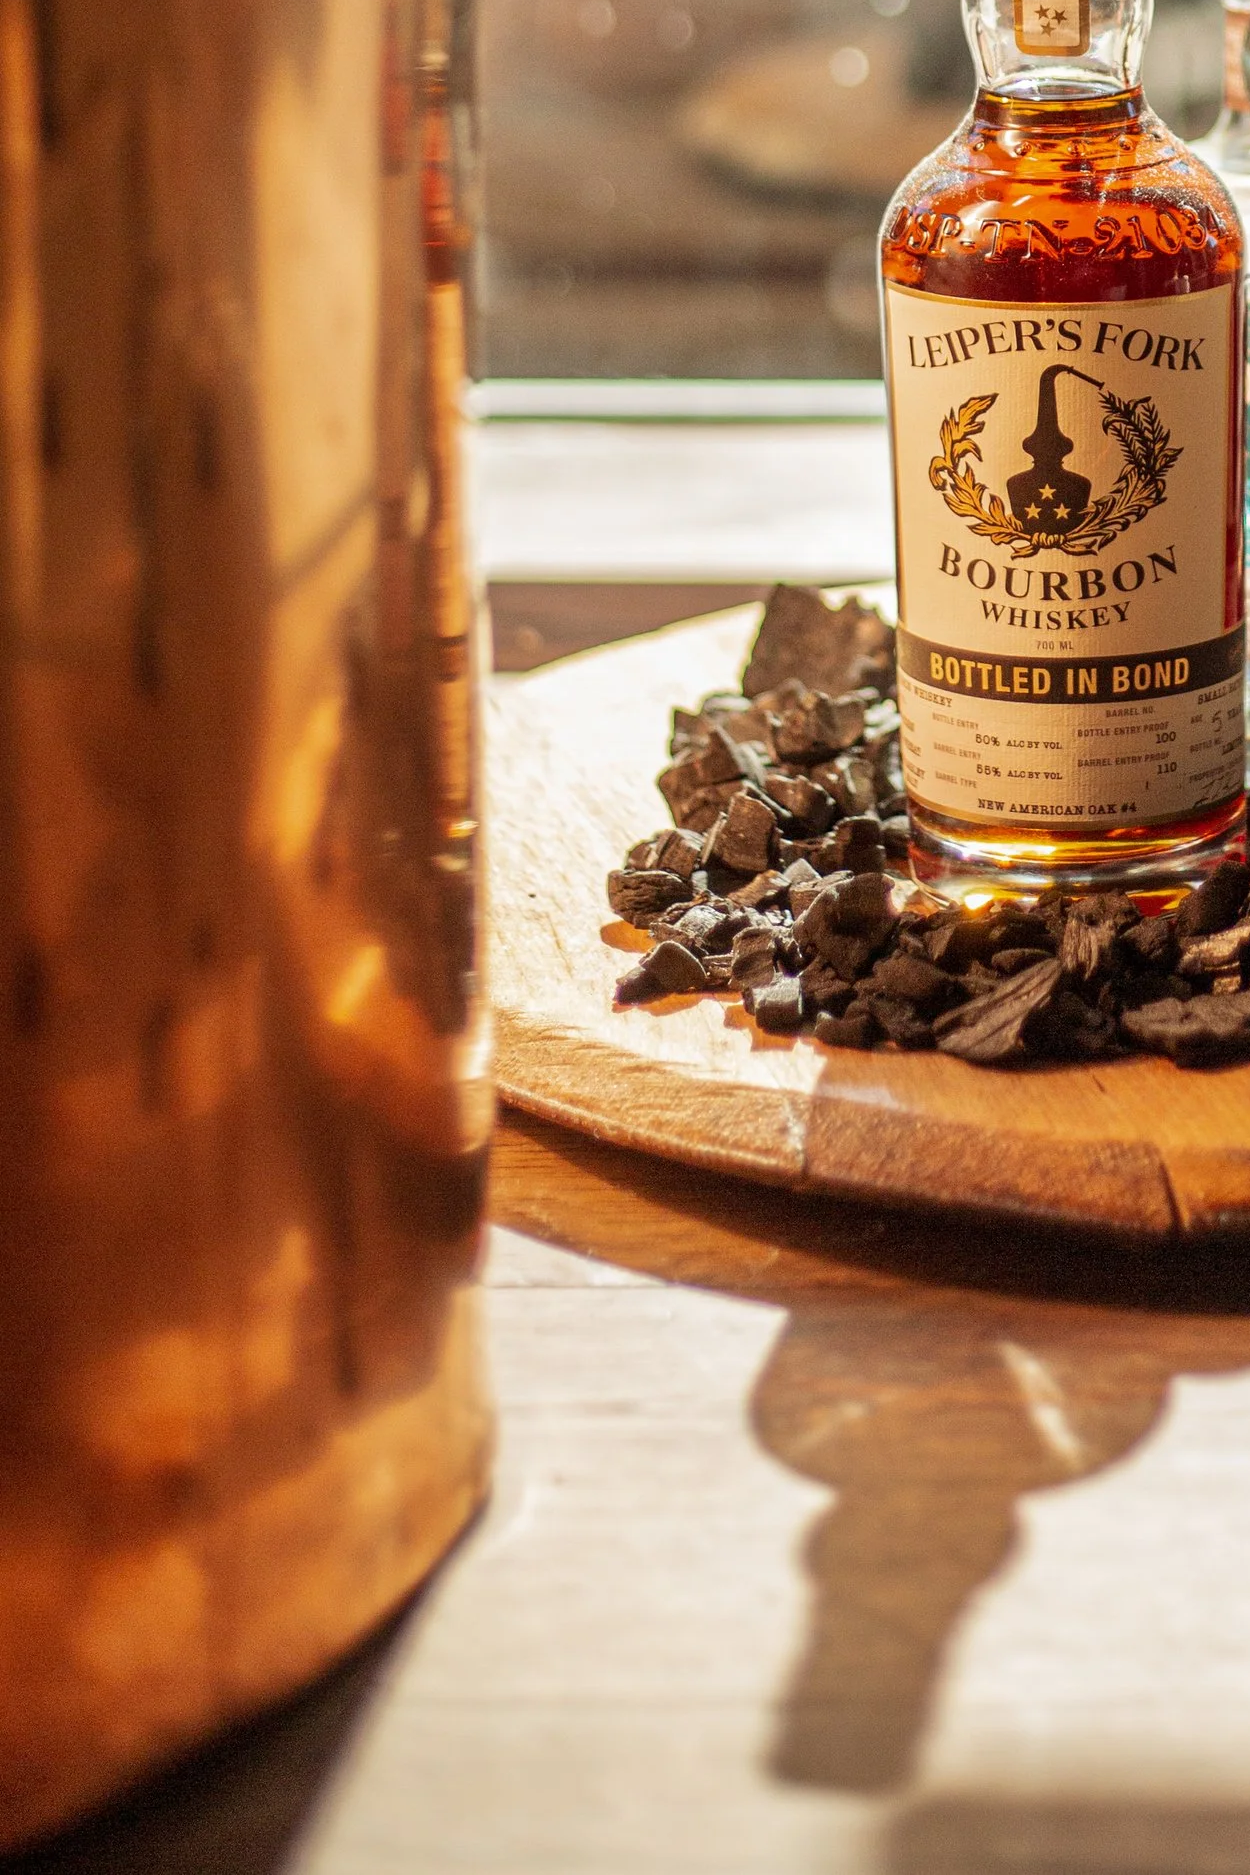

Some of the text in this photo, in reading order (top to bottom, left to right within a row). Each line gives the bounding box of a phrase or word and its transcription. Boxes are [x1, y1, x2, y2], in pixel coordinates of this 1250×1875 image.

[907, 318, 1206, 371] LEIPER'S FORK
[938, 542, 1180, 602] BOURBON
[980, 600, 1132, 631] WHISKEY
[1060, 640, 1074, 651] ML
[929, 651, 1052, 695] BOTTLED
[1066, 667, 1098, 696] IN
[1111, 657, 1191, 694] BOND
[914, 686, 953, 708] WHISKEY
[1105, 707, 1139, 719] BARREL
[1077, 721, 1170, 738] BOTTLE ENTRY PROOF
[1155, 731, 1177, 745] 100
[975, 733, 1000, 747] 50%
[1006, 740, 1025, 748] ALC
[1027, 740, 1040, 748] BY
[1077, 752, 1171, 768] BARREL ENTRY PROOF
[1156, 761, 1178, 775] 110
[976, 763, 1001, 778] 55%
[1007, 770, 1026, 779] ALC
[1027, 771, 1041, 780] BY
[977, 798, 1137, 816] NEW AMERICAN OAK #4
